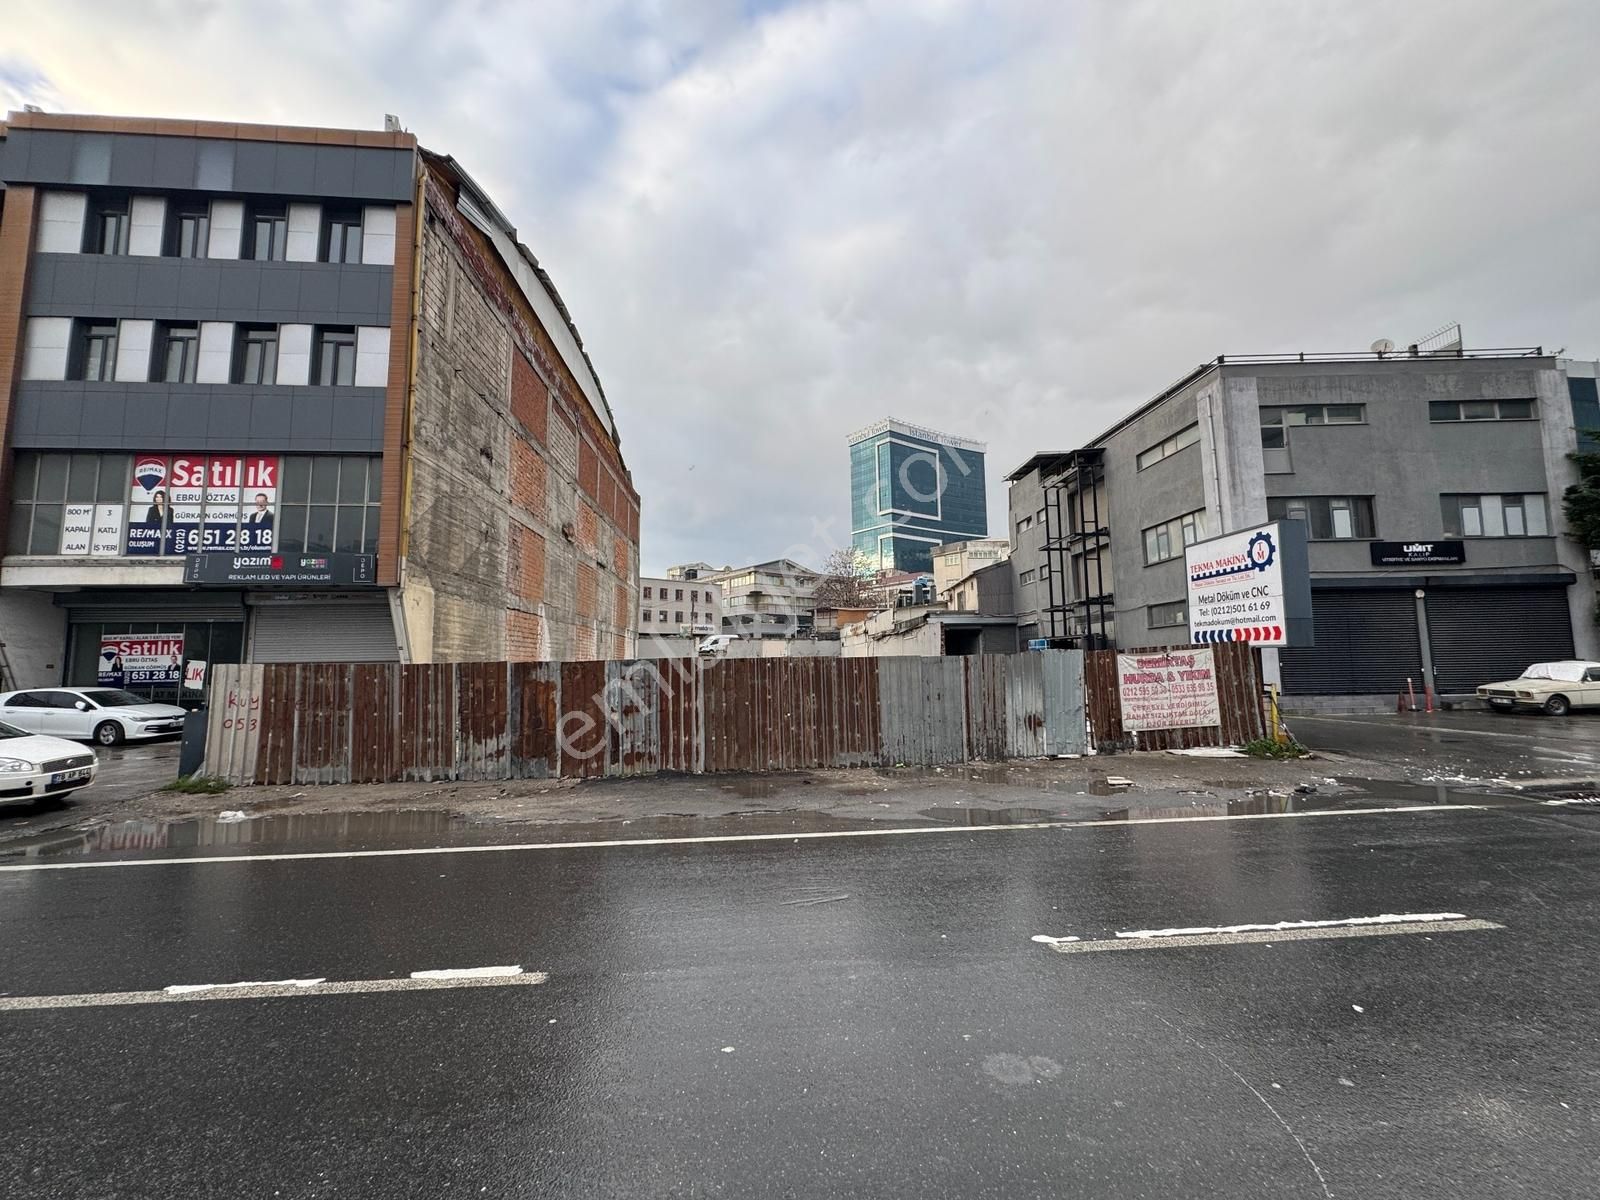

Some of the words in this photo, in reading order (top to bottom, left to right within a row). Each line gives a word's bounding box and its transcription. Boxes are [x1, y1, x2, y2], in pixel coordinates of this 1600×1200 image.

[941, 435, 962, 447] Tower
[171, 460, 274, 487] Satılık
[205, 493, 236, 502] ÖZTAŞ
[175, 511, 211, 519] GÜRKAN
[129, 528, 172, 539] RE/MAX
[188, 529, 220, 545] 651
[225, 529, 250, 545] 28
[255, 529, 273, 545] 18
[65, 543, 86, 551] ALAN
[1256, 550, 1265, 561] M
[233, 556, 272, 569] yazım
[1191, 561, 1215, 573] TEKMA
[1215, 553, 1248, 568] MAKİNA
[1198, 595, 1216, 605] Metal
[1216, 591, 1240, 603] Döküm
[1241, 589, 1250, 598] ve
[1251, 585, 1269, 598] CNC
[1199, 608, 1210, 617] Tel:
[1210, 603, 1246, 616] (0212)501
[1249, 602, 1258, 612] 61
[1259, 601, 1270, 611] 69
[1194, 615, 1277, 627] tekmadokum@hotmail.com
[119, 641, 180, 656] Satılık
[131, 671, 150, 680] 651
[152, 671, 166, 679] 28
[168, 670, 179, 679] 18
[1123, 671, 1164, 685] HURDA
[1166, 670, 1176, 682] &
[1178, 668, 1211, 681] YIKIM
[1122, 687, 1138, 697] 0212
[223, 718, 258, 731] 053
